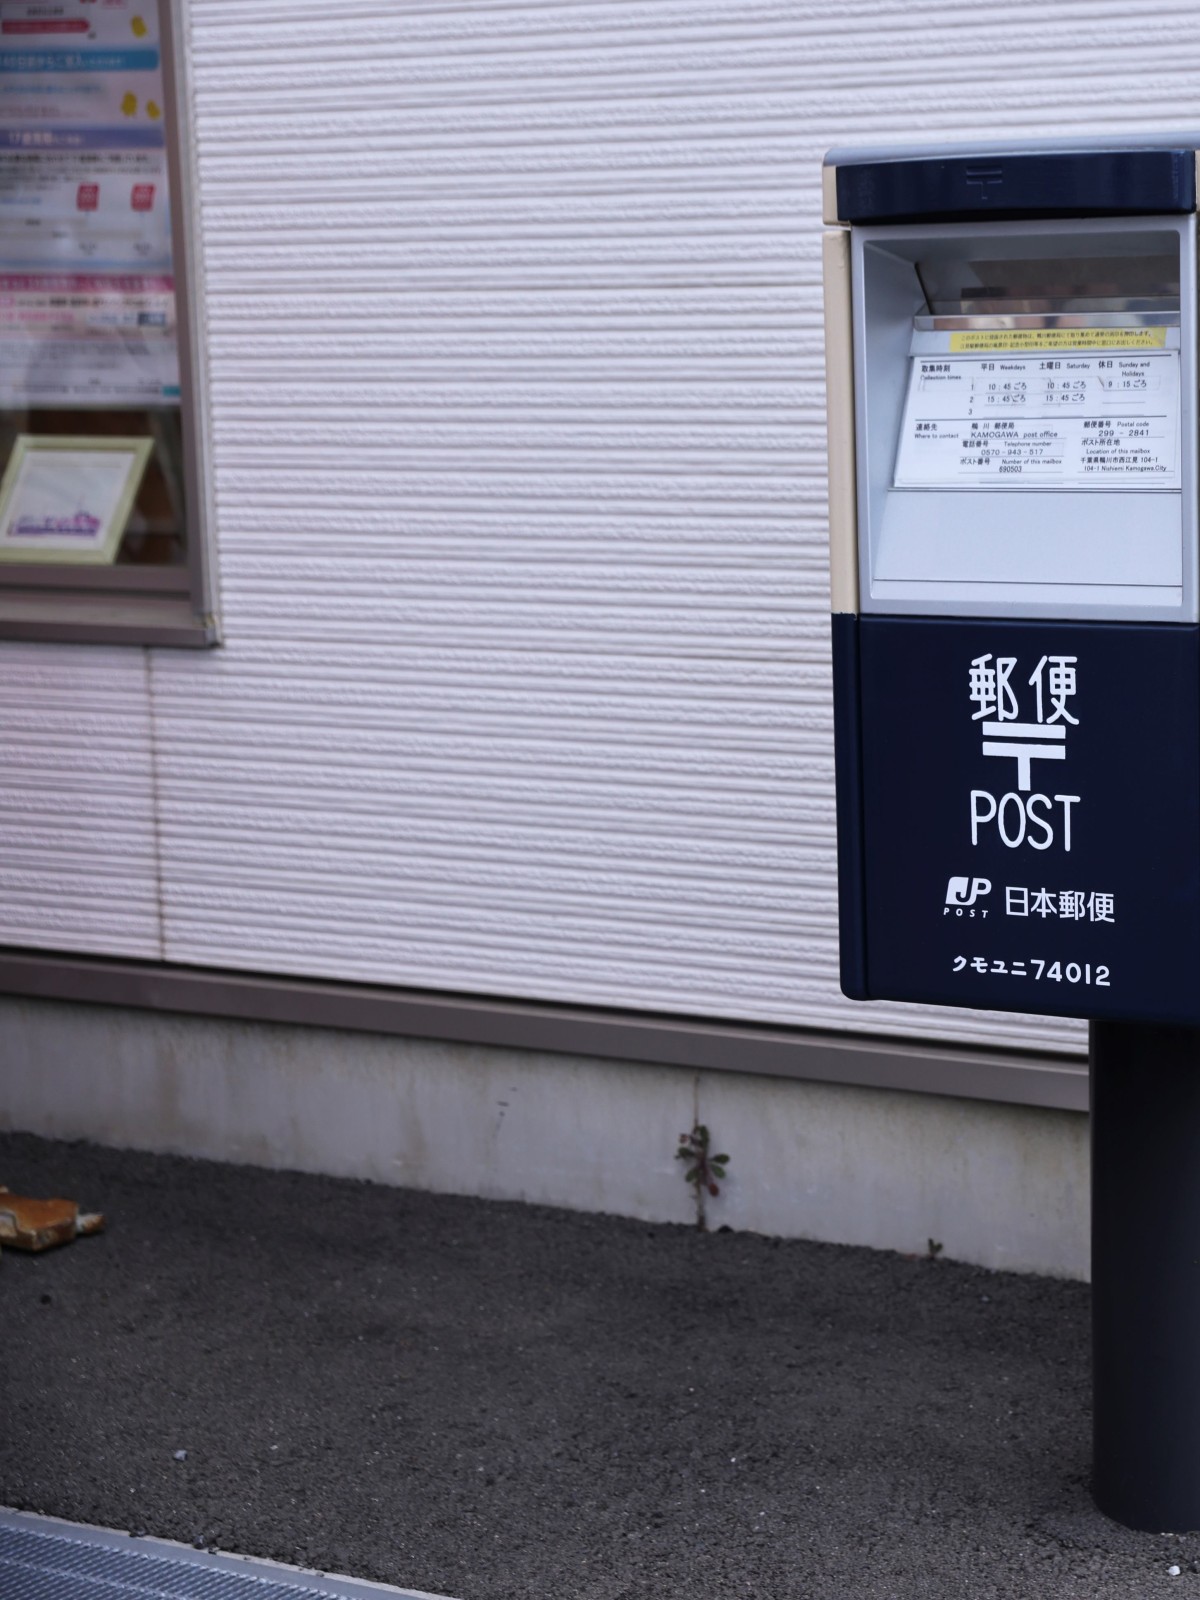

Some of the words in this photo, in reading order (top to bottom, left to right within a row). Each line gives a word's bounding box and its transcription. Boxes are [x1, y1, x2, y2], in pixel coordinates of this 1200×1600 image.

[921, 364, 951, 373] 取集時刻
[981, 363, 995, 371] 平日
[1039, 361, 1061, 370] 土曜日
[1098, 360, 1113, 369] 休日
[916, 423, 938, 431] 連絡先
[1083, 421, 1111, 429] 郵便番号
[962, 440, 989, 448] 電話番号
[1081, 438, 1120, 447] ポスト所在地
[960, 457, 990, 466] ポスト番号
[968, 654, 1079, 725] 郵便
[970, 790, 1081, 852] POST
[1005, 886, 1116, 923] 日本郵便
[943, 907, 989, 919] POST
[952, 955, 1111, 986] クモユニ74012
